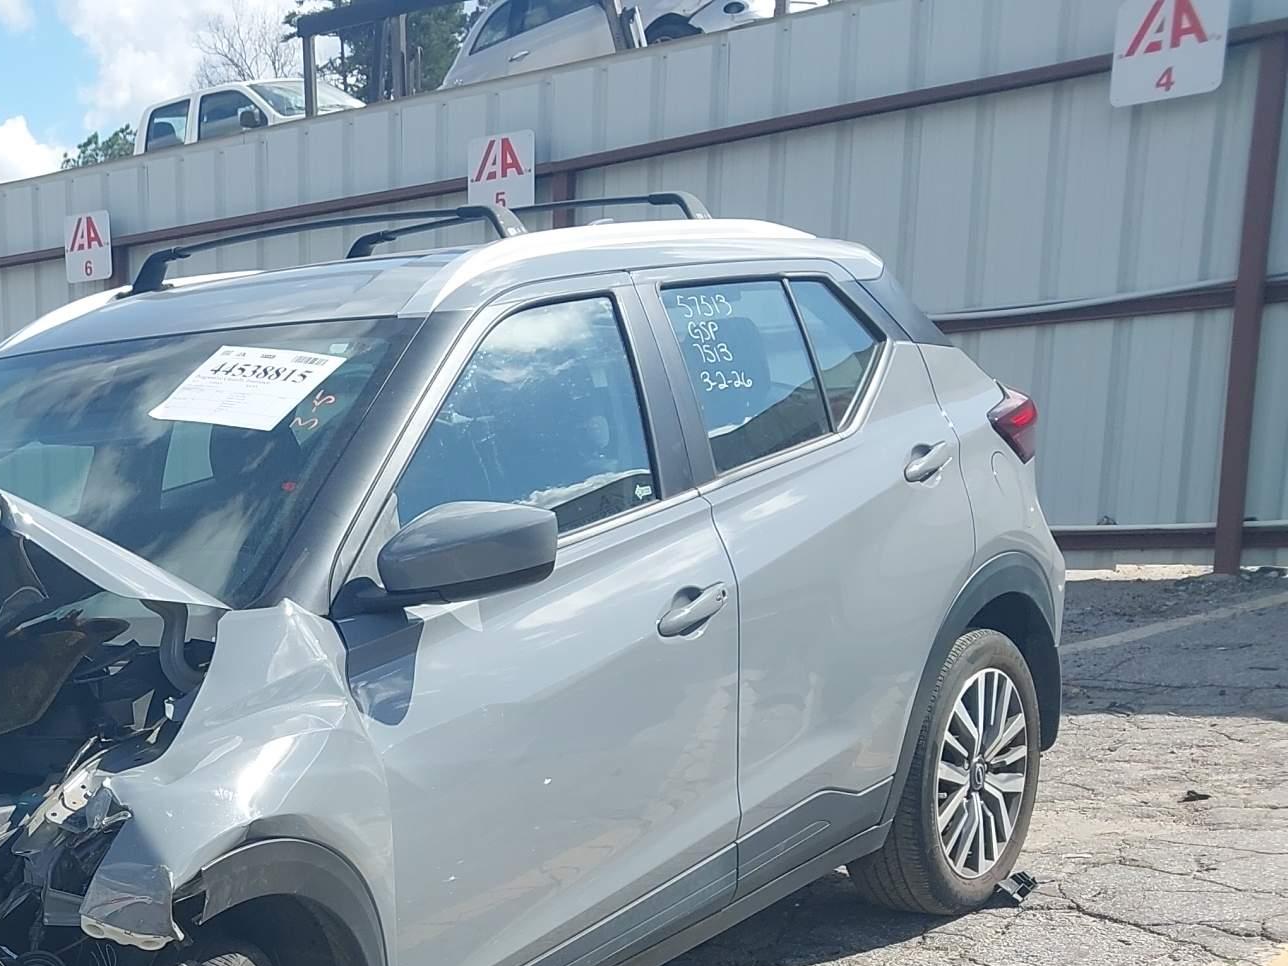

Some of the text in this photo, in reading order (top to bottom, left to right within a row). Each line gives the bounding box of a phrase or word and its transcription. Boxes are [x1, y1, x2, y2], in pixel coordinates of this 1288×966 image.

[1155, 66, 1175, 92] 4
[495, 191, 506, 207] 5
[84, 260, 93, 276] 6
[676, 294, 732, 317] 57513
[688, 321, 718, 342] GSP
[692, 343, 733, 362] 7513
[210, 361, 314, 384] 44538815
[700, 370, 753, 391] 3-2-26
